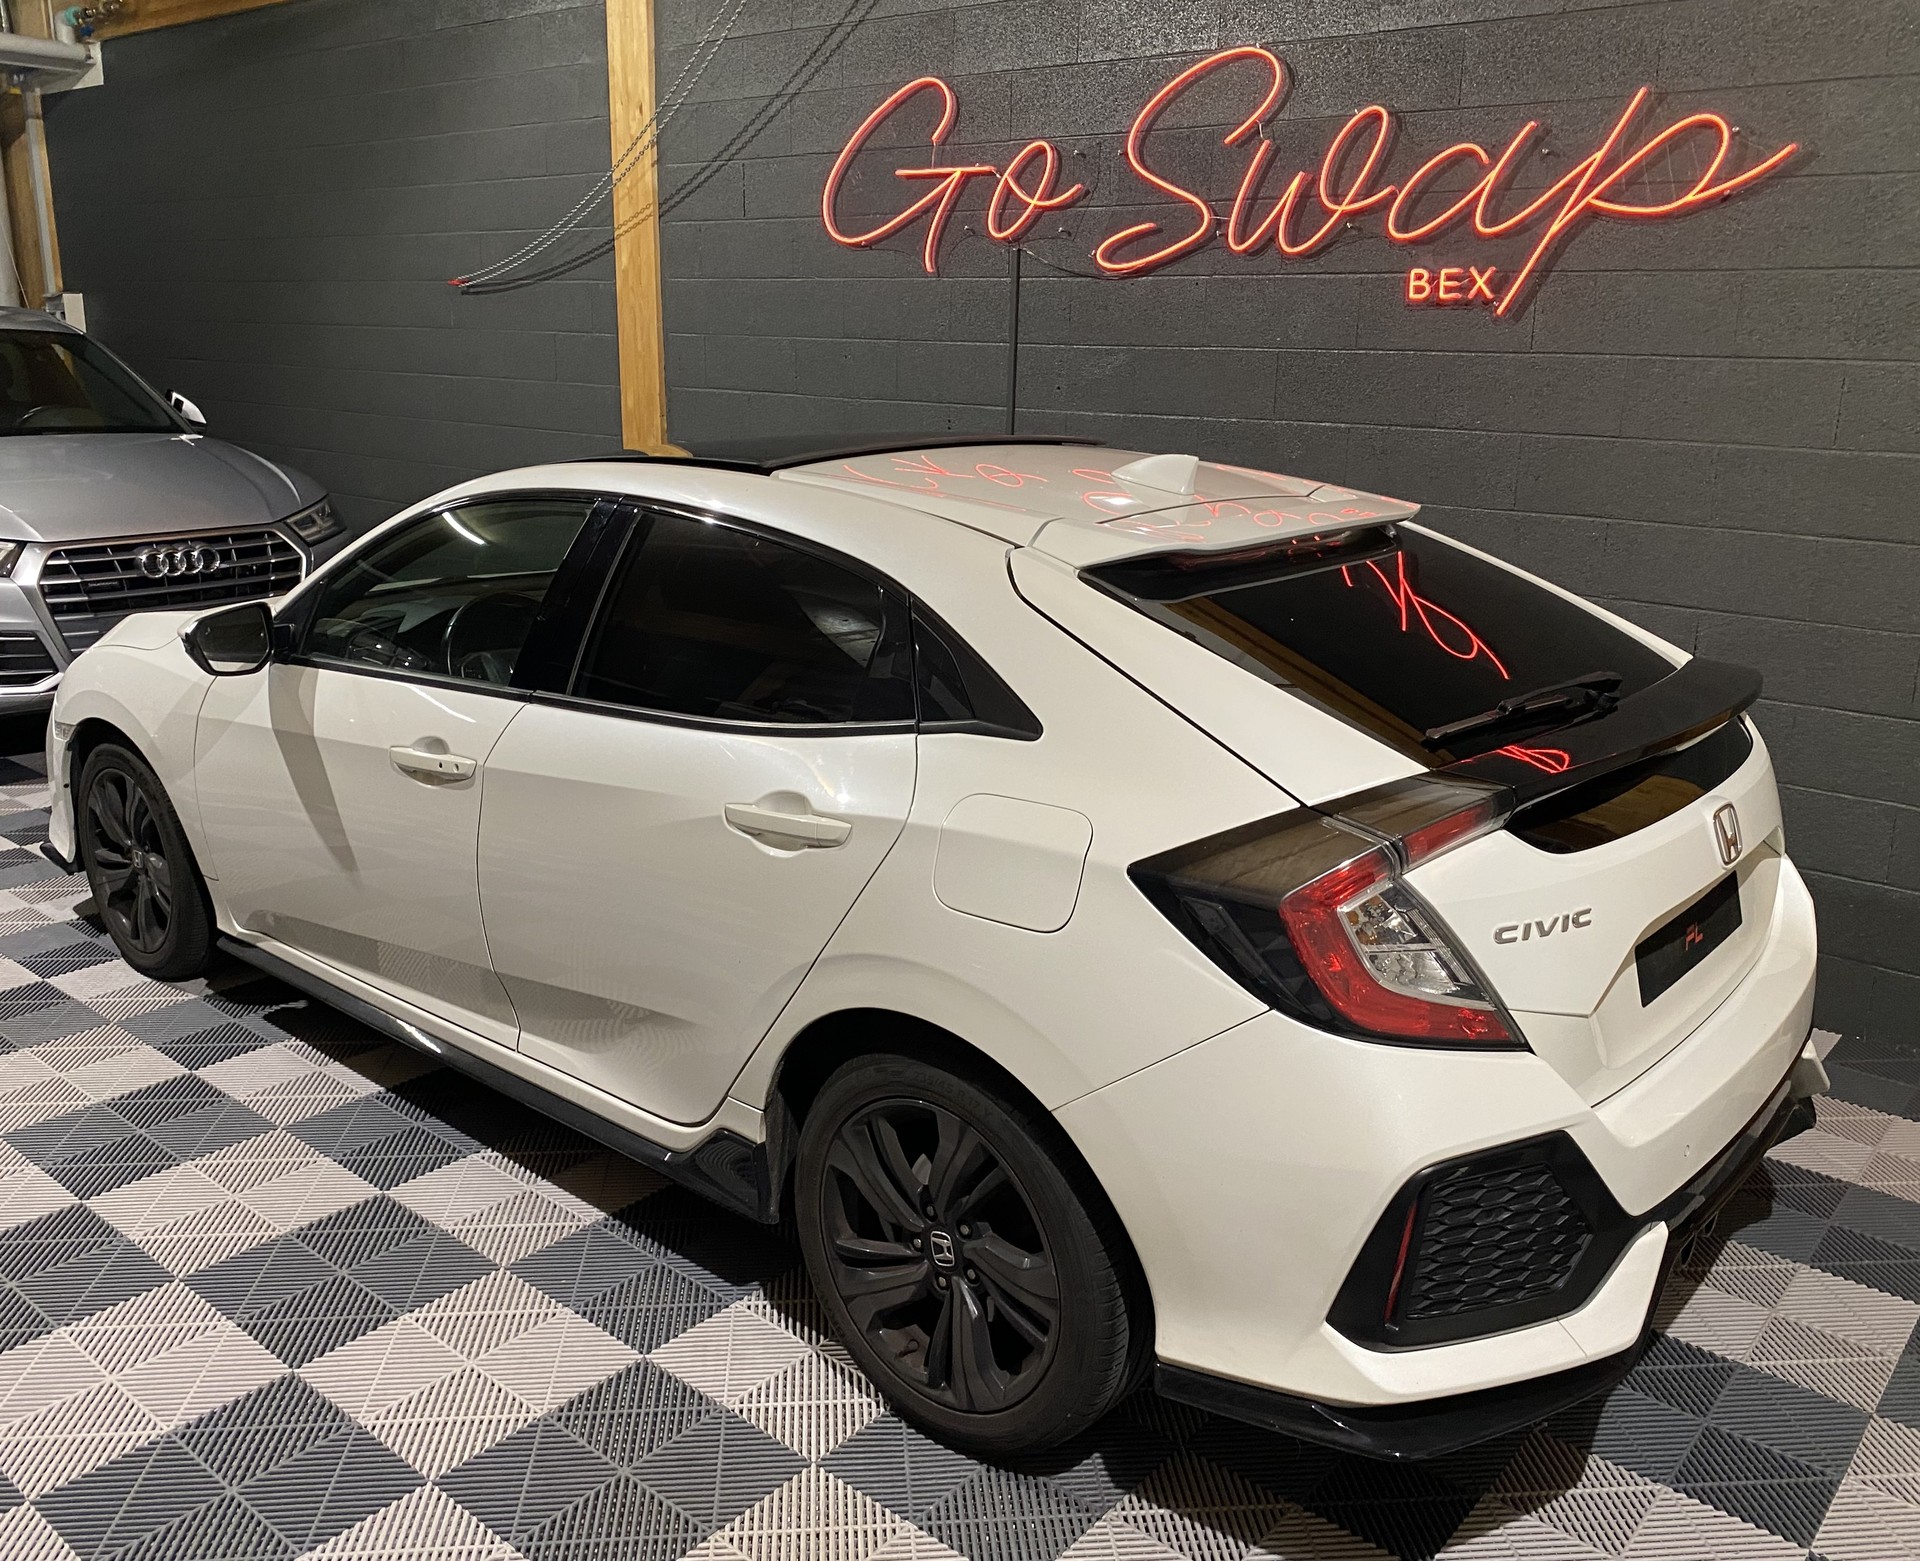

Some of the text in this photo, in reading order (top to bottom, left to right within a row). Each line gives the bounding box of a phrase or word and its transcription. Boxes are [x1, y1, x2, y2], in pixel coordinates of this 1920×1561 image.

[822, 46, 1797, 316] Go Swap
[1407, 266, 1498, 301] BEX
[1493, 907, 1593, 945] CIVIC
